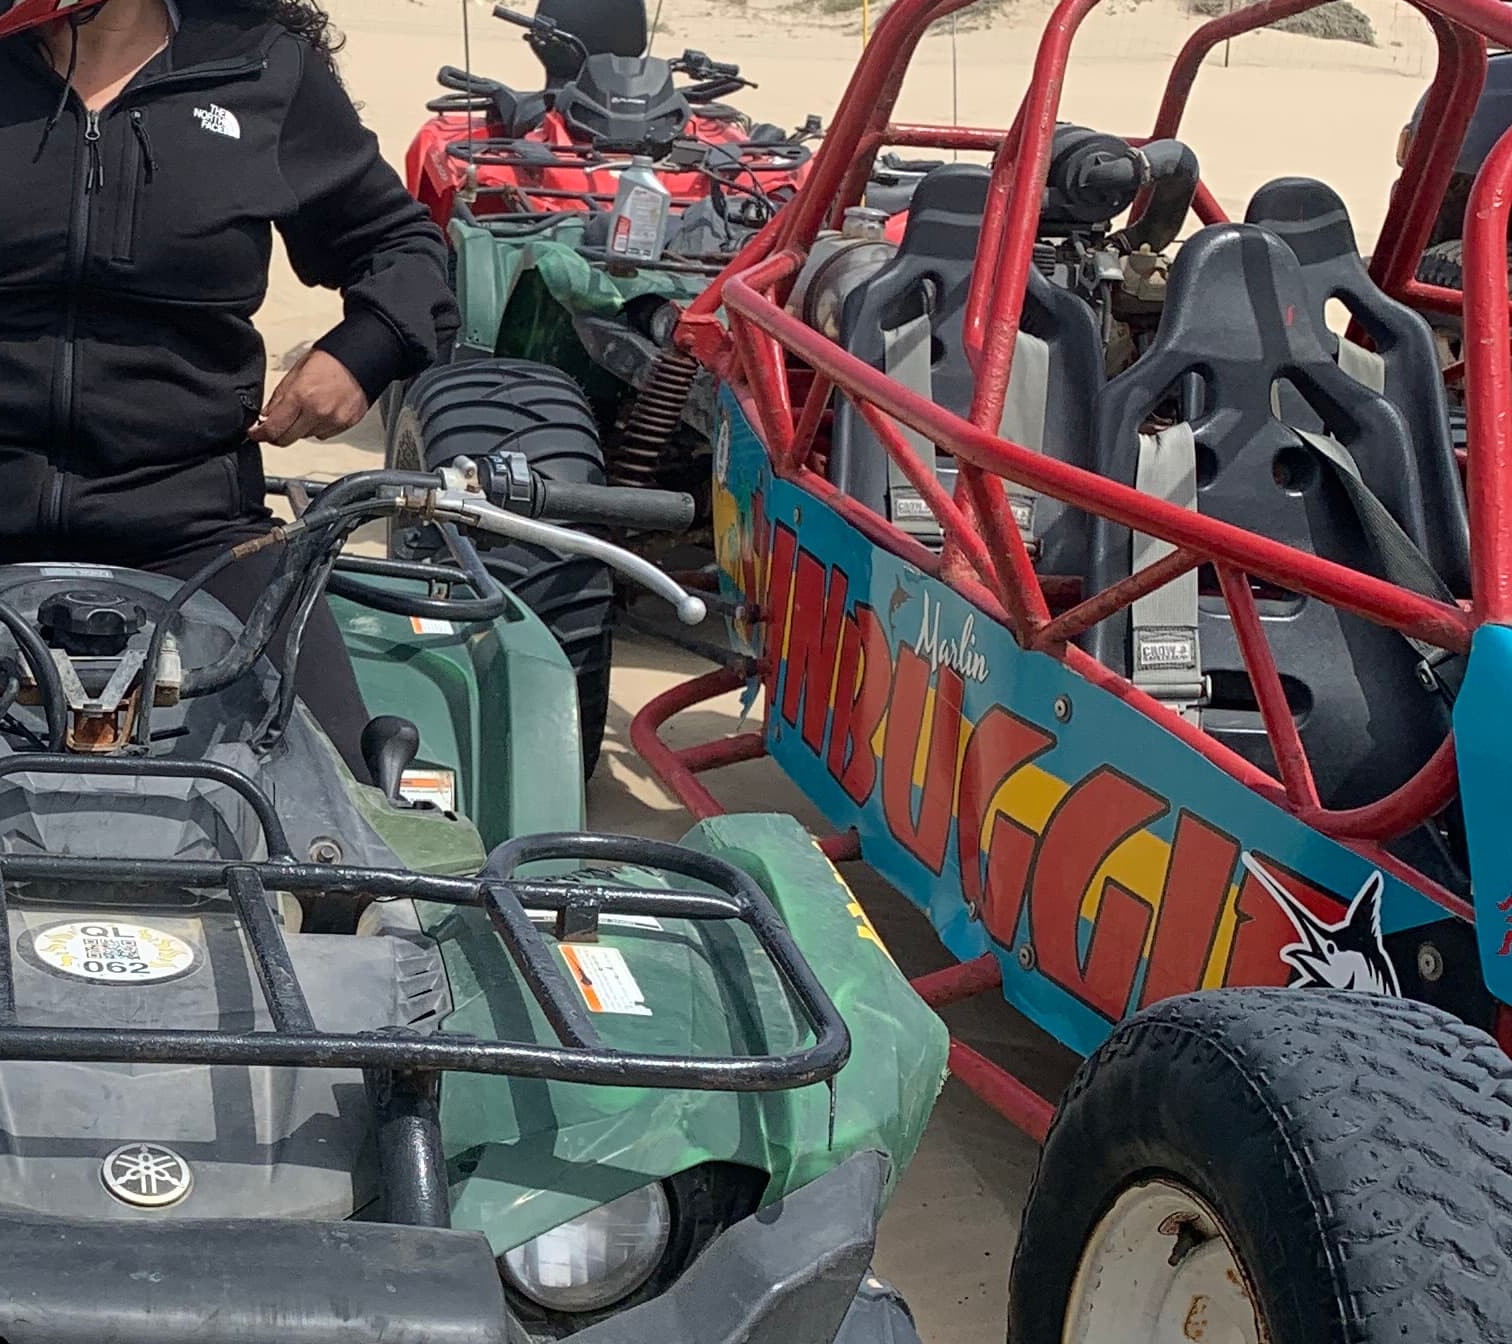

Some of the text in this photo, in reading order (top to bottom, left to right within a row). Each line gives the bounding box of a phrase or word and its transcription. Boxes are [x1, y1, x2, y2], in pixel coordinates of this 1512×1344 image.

[914, 589, 989, 682] Marlin
[80, 925, 135, 938] QL
[83, 960, 151, 974] 062
